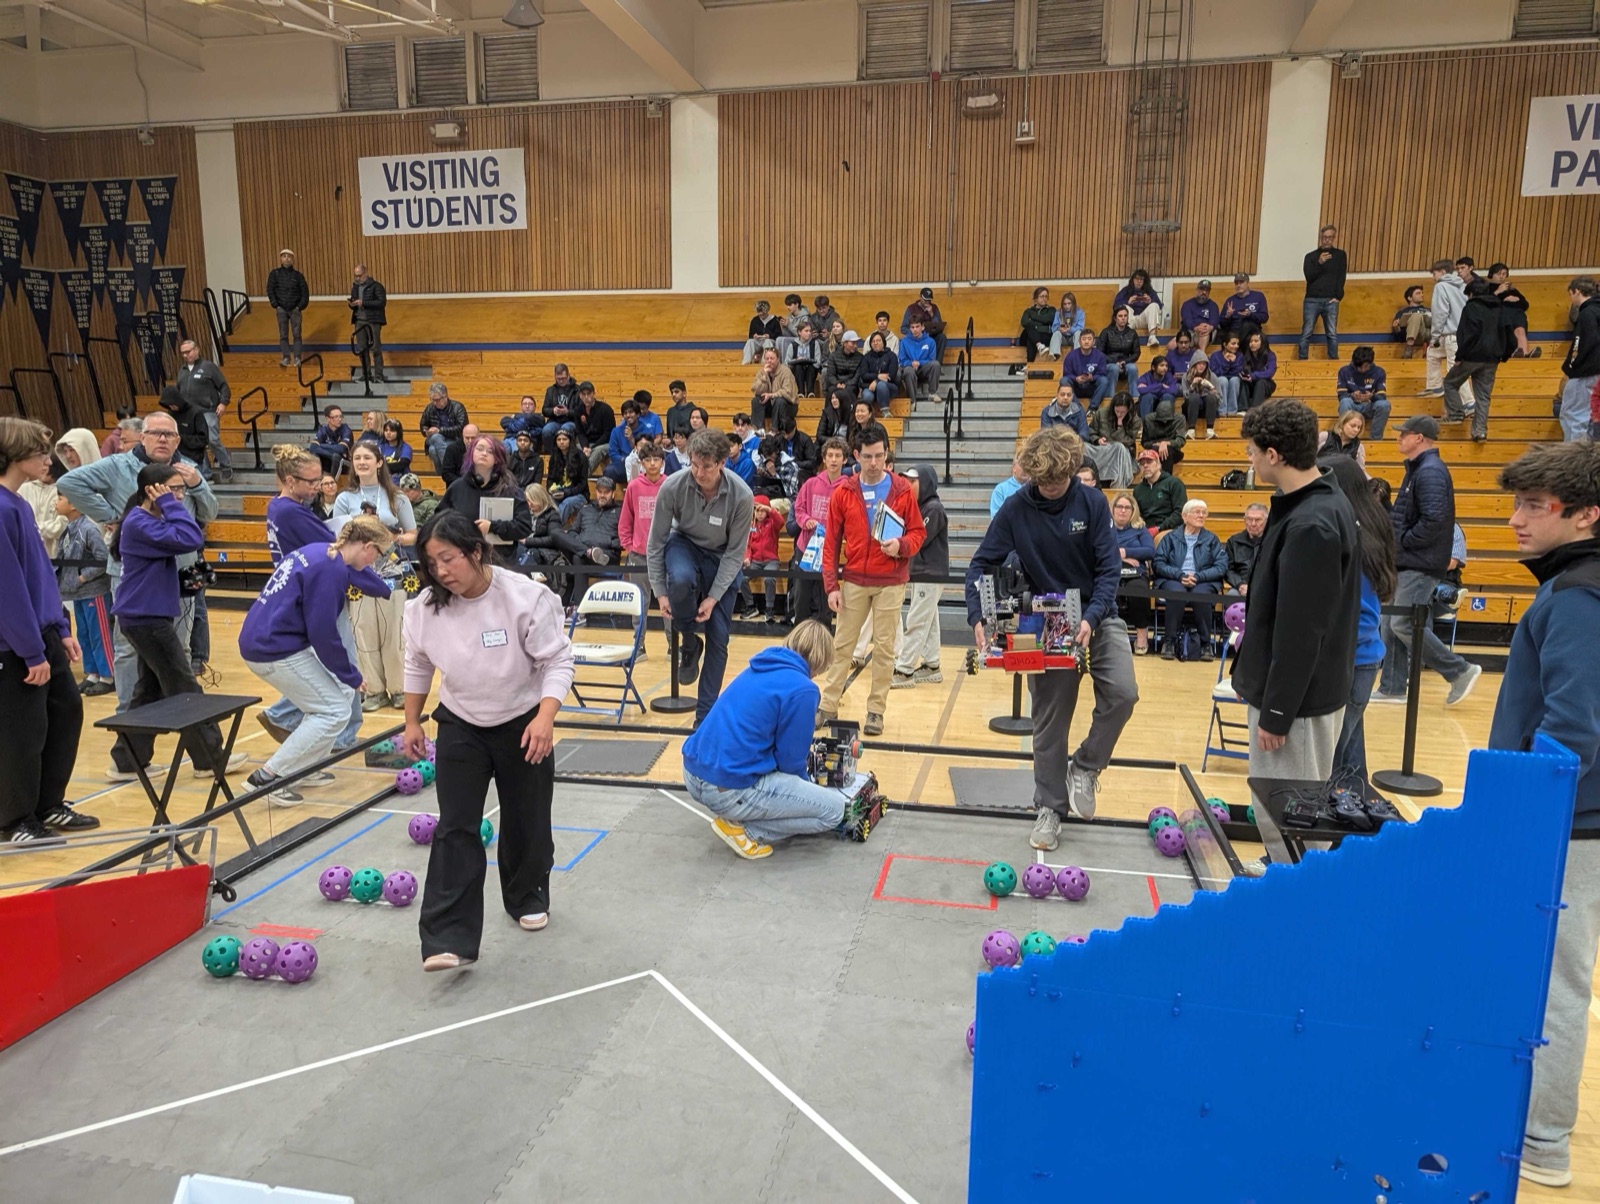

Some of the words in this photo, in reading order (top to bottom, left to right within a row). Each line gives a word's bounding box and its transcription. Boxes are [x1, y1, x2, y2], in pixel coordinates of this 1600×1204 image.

[382, 156, 500, 192] VISITING
[371, 193, 517, 230] STUDENTS
[588, 591, 634, 602] ACALANES
